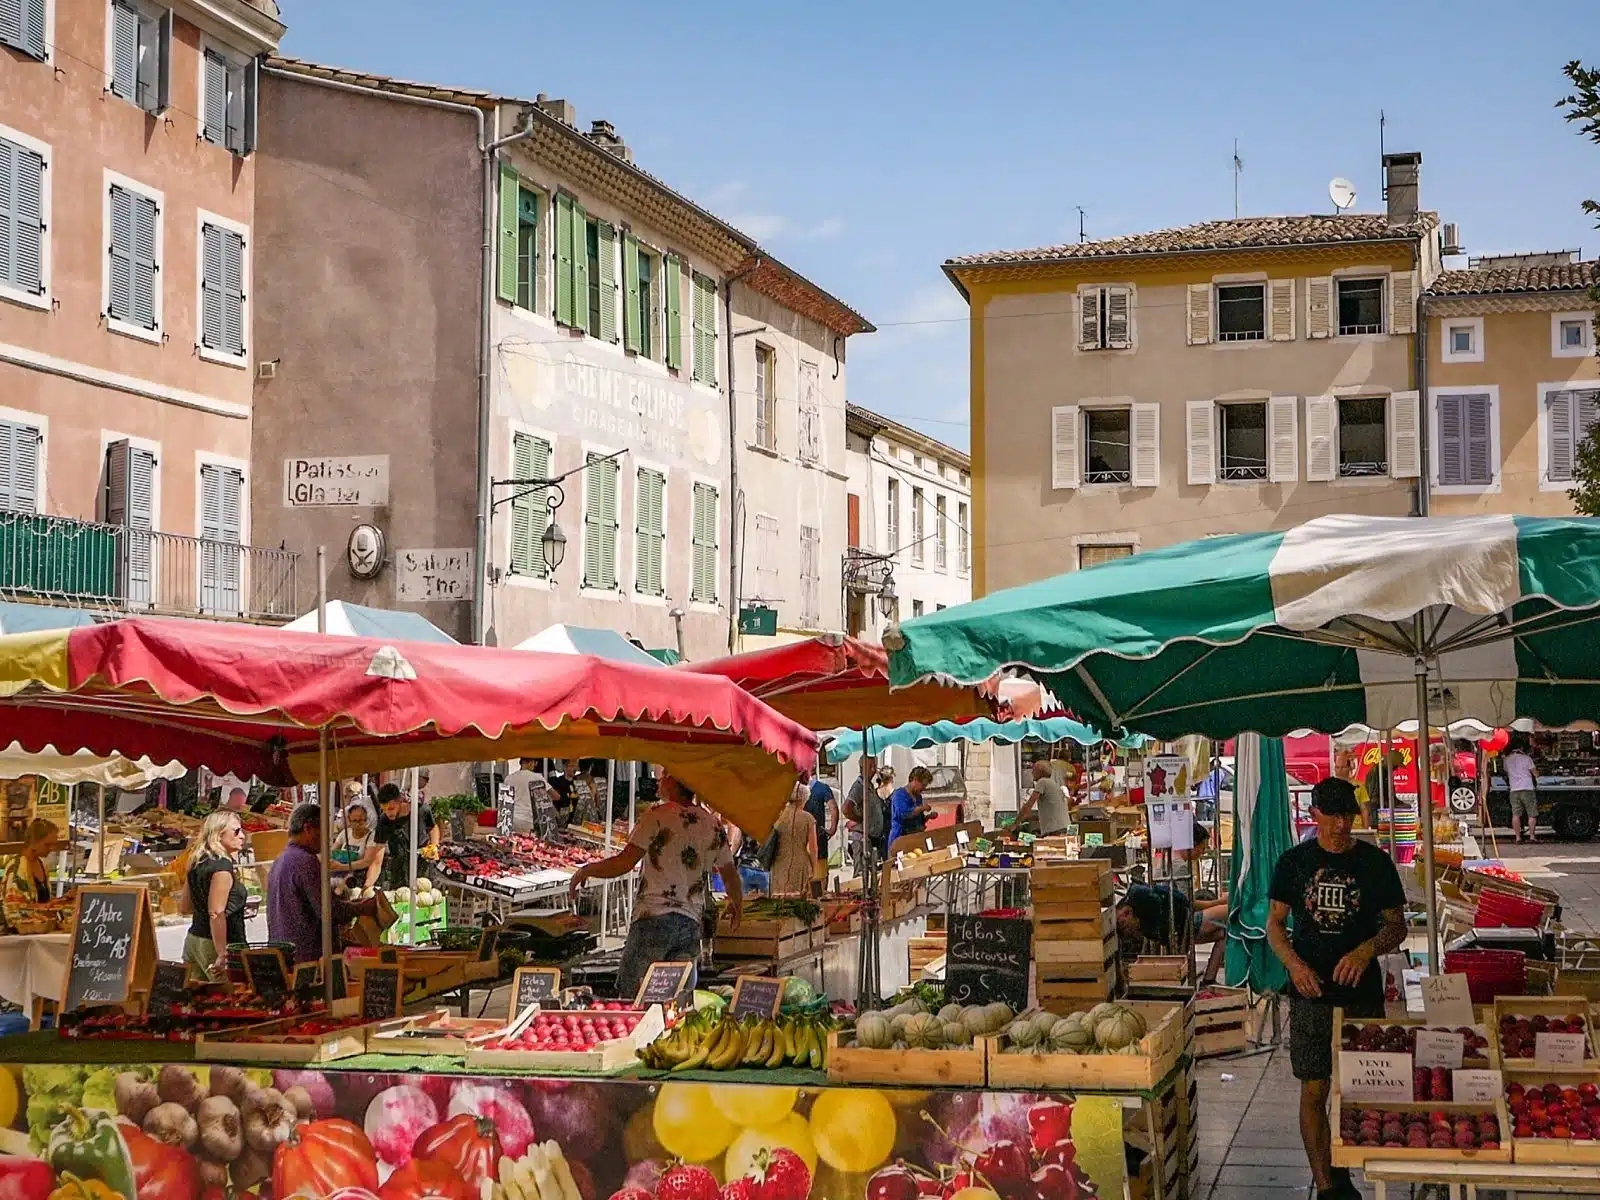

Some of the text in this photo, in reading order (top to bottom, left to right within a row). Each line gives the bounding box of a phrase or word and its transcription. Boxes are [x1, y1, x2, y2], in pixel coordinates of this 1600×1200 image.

[38, 780, 60, 803] AB
[1317, 886, 1346, 908] FEEL
[954, 920, 1006, 943] Melons
[1358, 1059, 1393, 1069] VENTE
[1365, 1069, 1386, 1078] AUX
[1351, 1078, 1405, 1088] PLATEAUX
